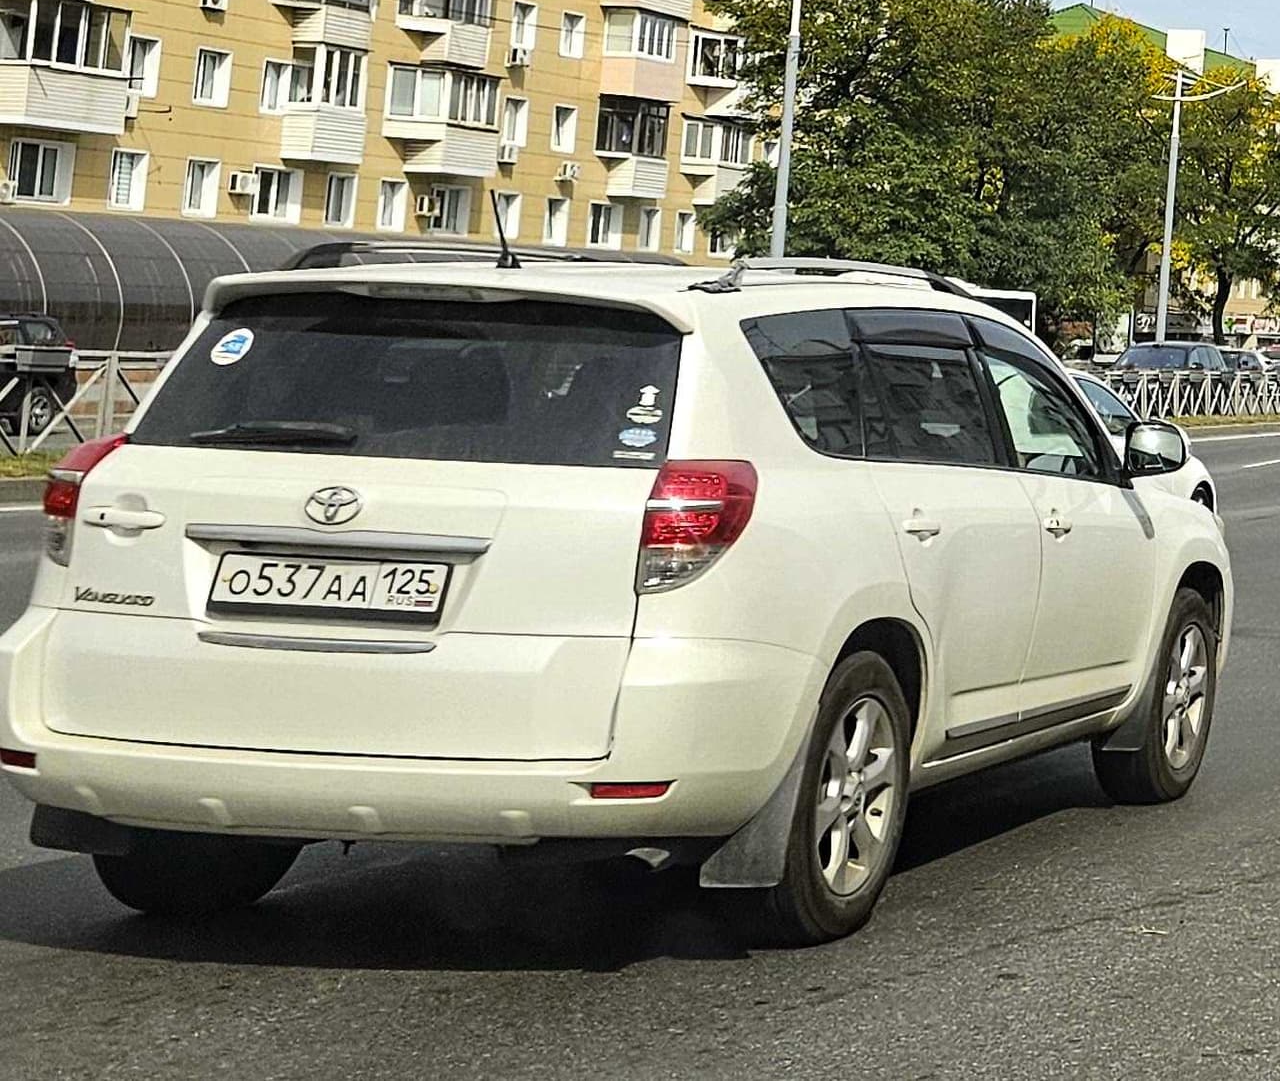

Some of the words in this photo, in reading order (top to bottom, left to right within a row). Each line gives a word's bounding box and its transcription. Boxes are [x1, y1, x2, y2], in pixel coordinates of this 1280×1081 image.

[228, 562, 367, 603] О537АА
[382, 566, 435, 595] 125
[385, 594, 414, 607] RUS
